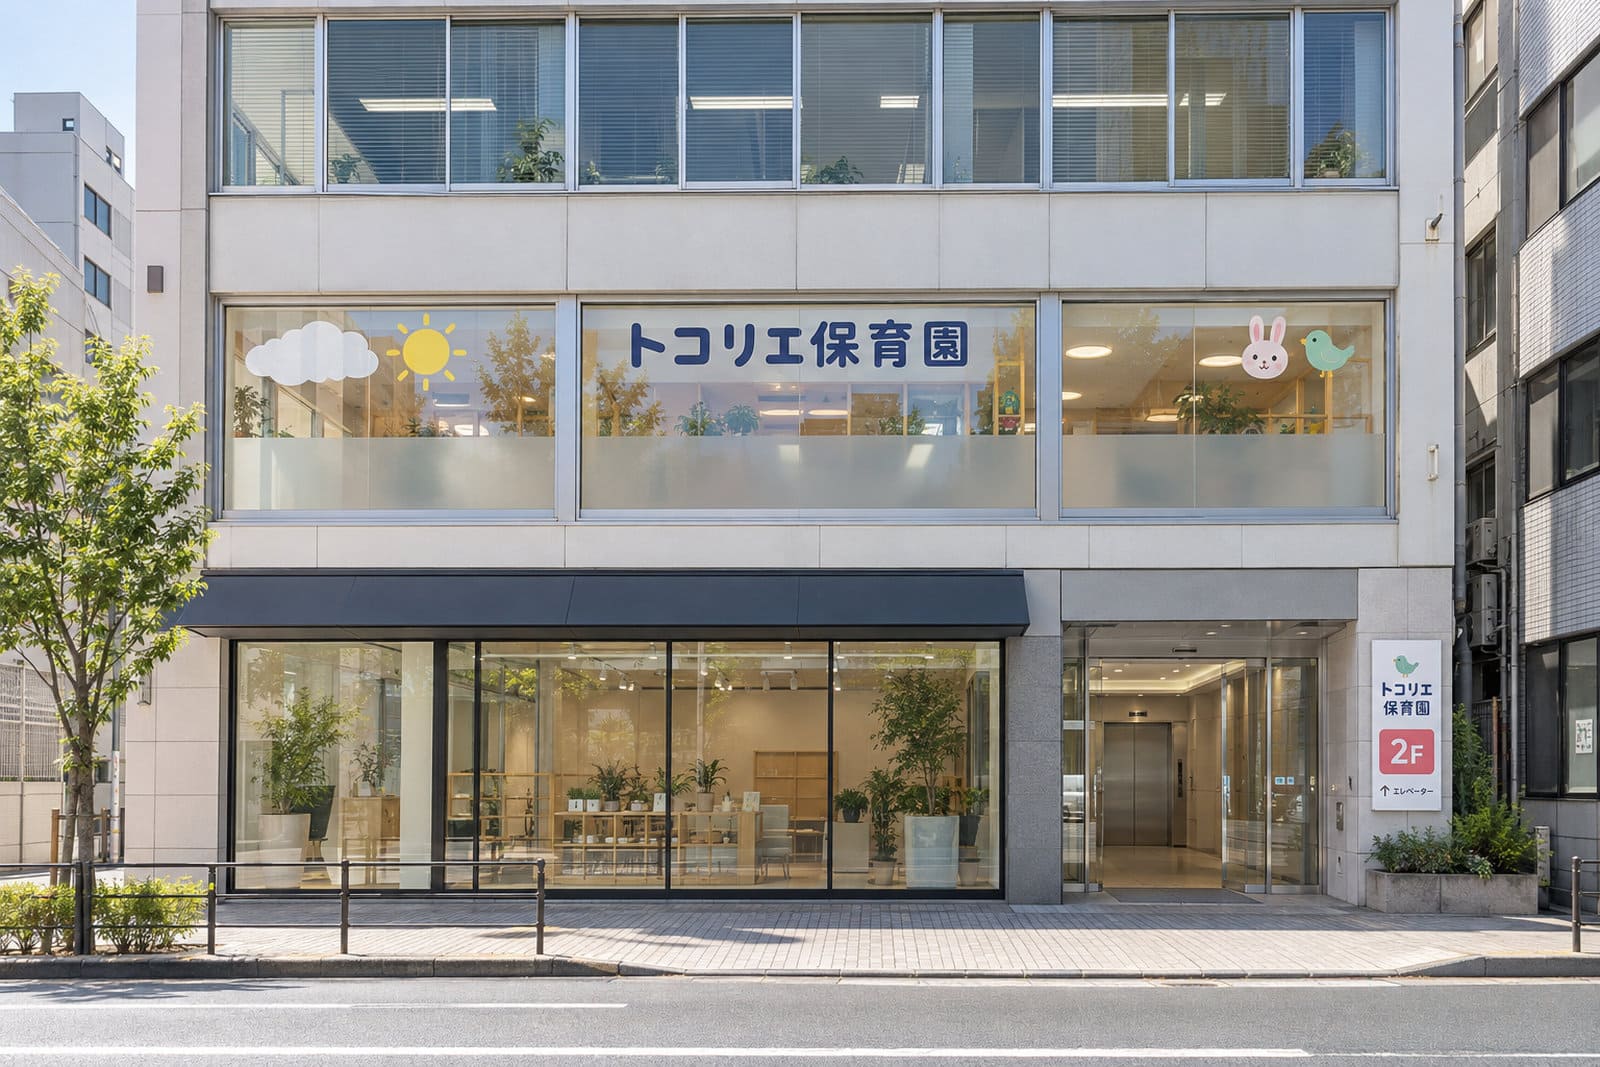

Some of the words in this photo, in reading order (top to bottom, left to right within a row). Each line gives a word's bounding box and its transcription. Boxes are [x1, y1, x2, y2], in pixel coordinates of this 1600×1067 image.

[631, 319, 967, 368] トコリエ保育園
[1382, 682, 1432, 697] トコリエ
[1391, 738, 1423, 764] 2F
